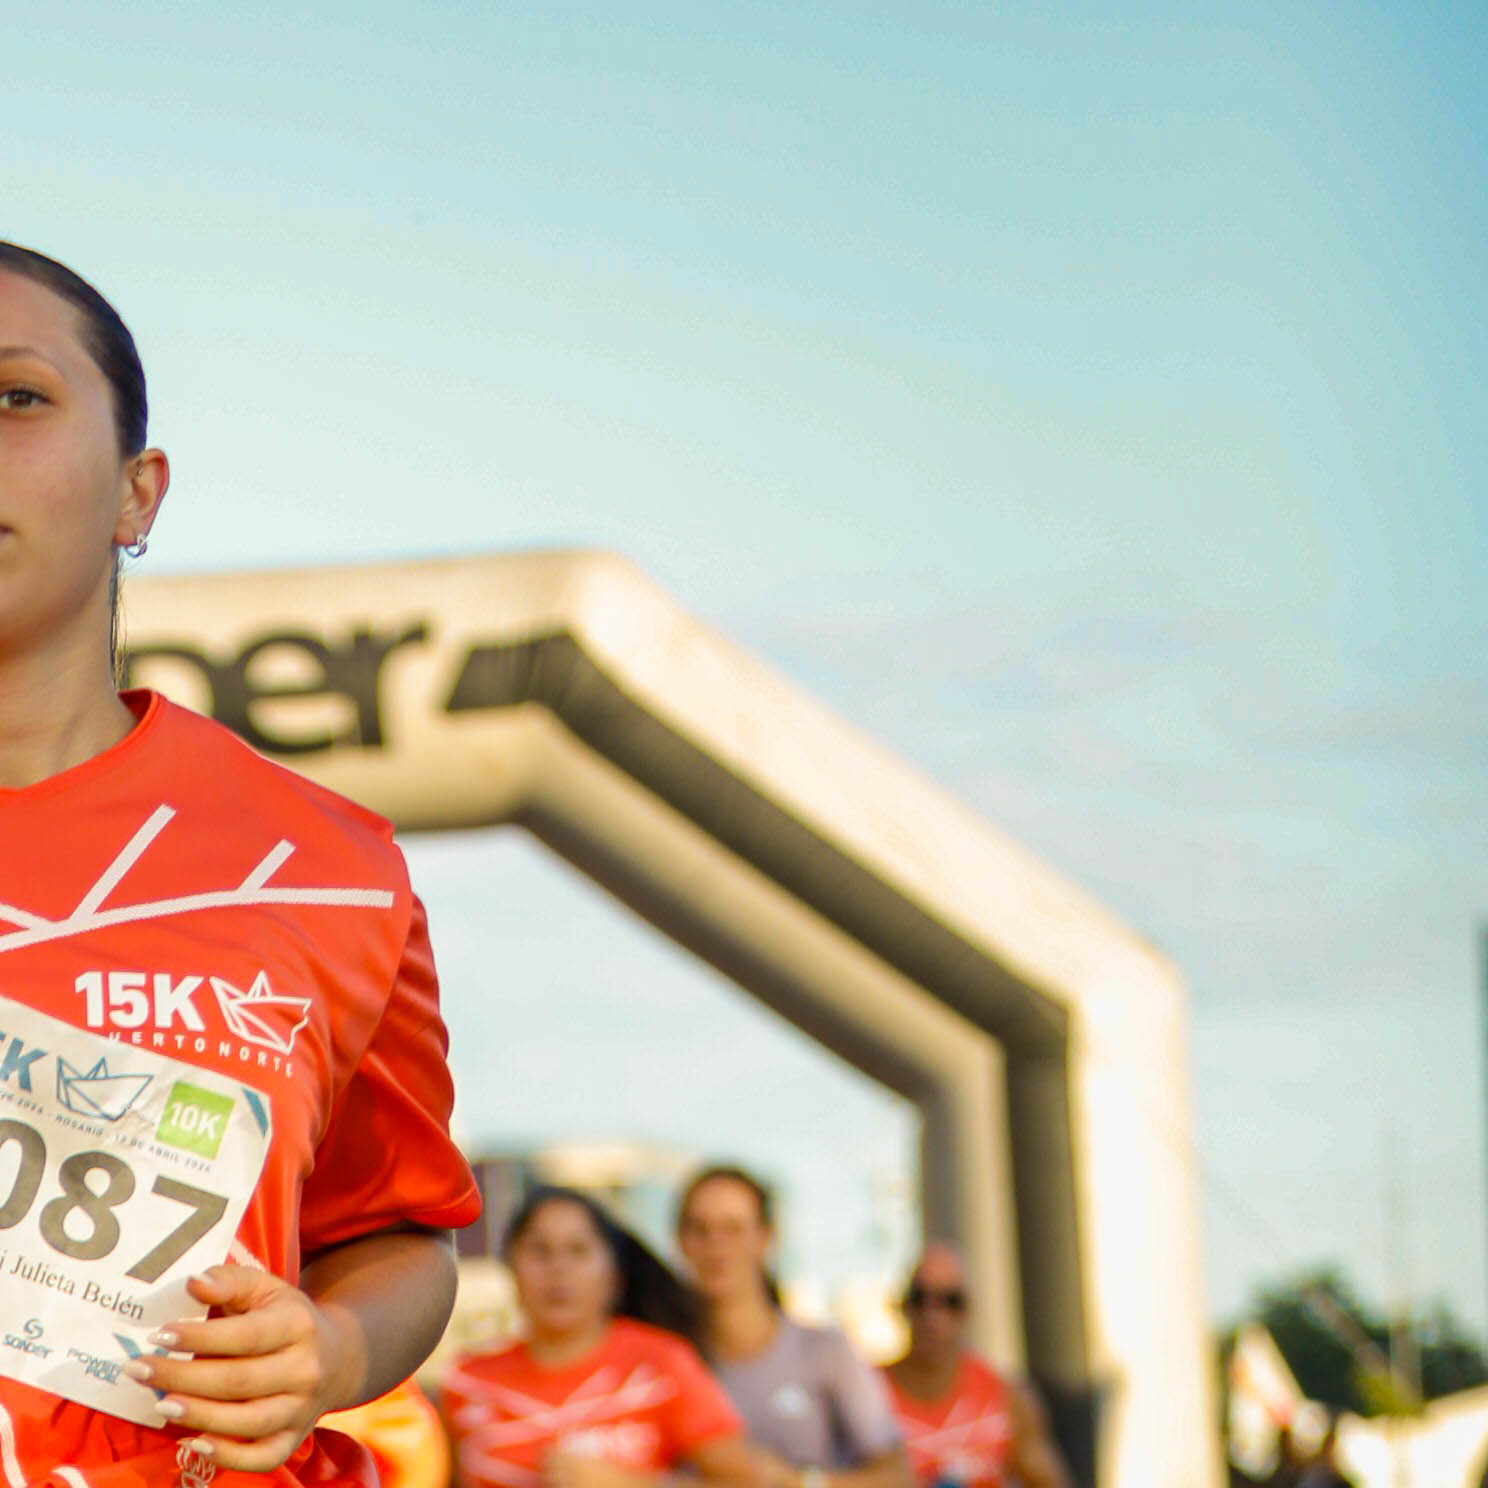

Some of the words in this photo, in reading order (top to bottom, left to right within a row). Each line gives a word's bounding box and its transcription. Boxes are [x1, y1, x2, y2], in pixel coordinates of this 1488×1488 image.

[74, 970, 207, 1032] 15K
[108, 1031, 206, 1053] UERTO
[219, 1042, 294, 1078] NORTE
[169, 1101, 220, 1143] 10K
[10, 1254, 76, 1296] Julieta
[81, 1281, 145, 1321] Belén
